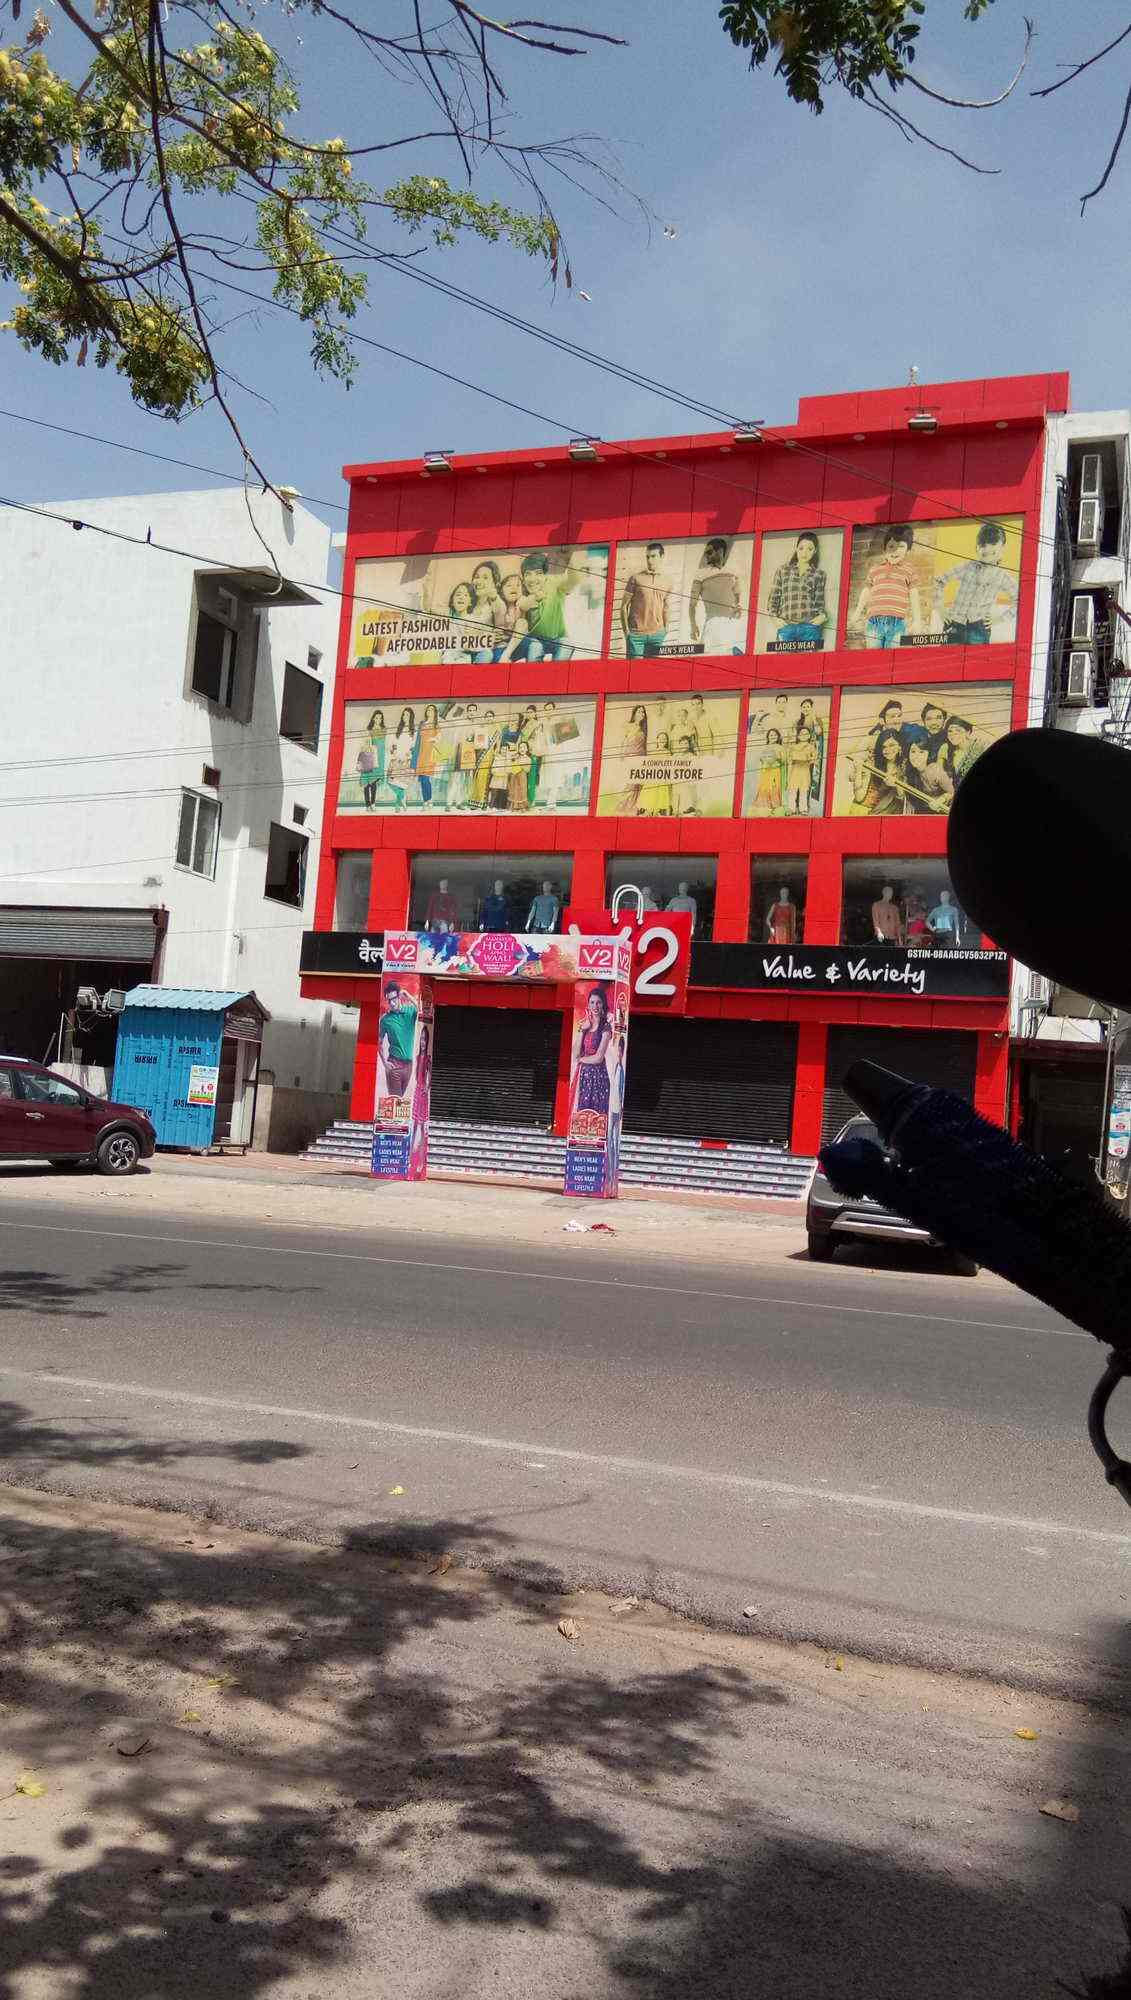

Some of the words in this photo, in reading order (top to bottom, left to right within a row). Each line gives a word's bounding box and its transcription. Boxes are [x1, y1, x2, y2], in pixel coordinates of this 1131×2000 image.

[362, 621, 399, 636] LATEST
[401, 618, 450, 634] FASHION
[387, 636, 457, 653] AFFORDABLE
[461, 634, 494, 649] PRICE
[775, 641, 797, 651] LADIES
[798, 640, 815, 650] WEAR
[912, 635, 929, 646] KIDS
[930, 634, 948, 644] WEAR
[679, 644, 696, 654] WEAR
[647, 759, 673, 767] COMPLETE
[674, 759, 692, 767] FAMILY
[629, 768, 671, 780] FASHION
[673, 768, 704, 780] STORE
[389, 944, 417, 961] V2
[482, 940, 514, 951] HOLI
[581, 948, 612, 965] V2
[619, 950, 630, 971] V2
[762, 955, 816, 979] Value
[825, 963, 842, 984] &
[847, 958, 926, 994] Variety
